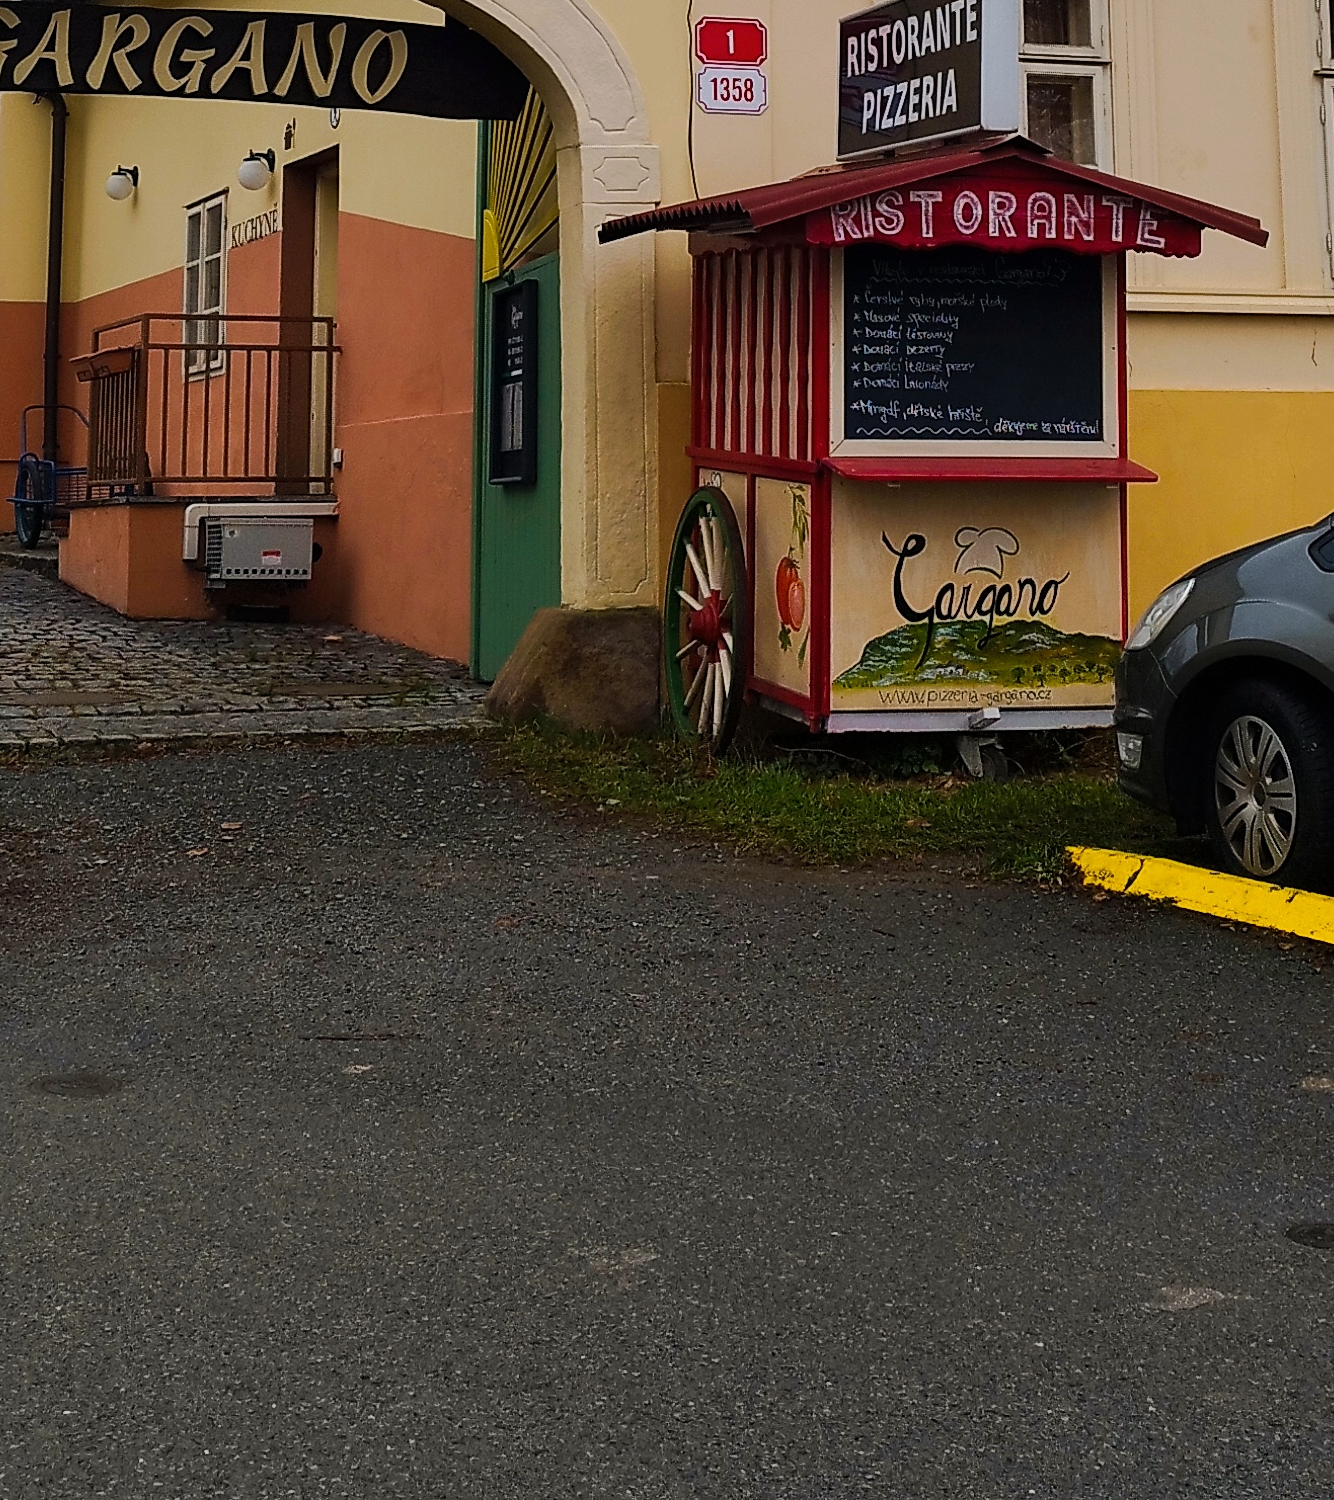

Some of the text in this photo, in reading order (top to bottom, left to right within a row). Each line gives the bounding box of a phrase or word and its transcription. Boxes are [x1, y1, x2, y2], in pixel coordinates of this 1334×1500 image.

[725, 28, 735, 54] 1
[710, 77, 754, 102] 1358
[862, 68, 958, 135] PIZZERIA
[230, 202, 278, 249] KUCHYNĚ
[830, 190, 1166, 249] RISTORANTE
[881, 530, 1070, 670] Gargano
[878, 689, 1052, 707] www.pizzeria-gargano.cz
